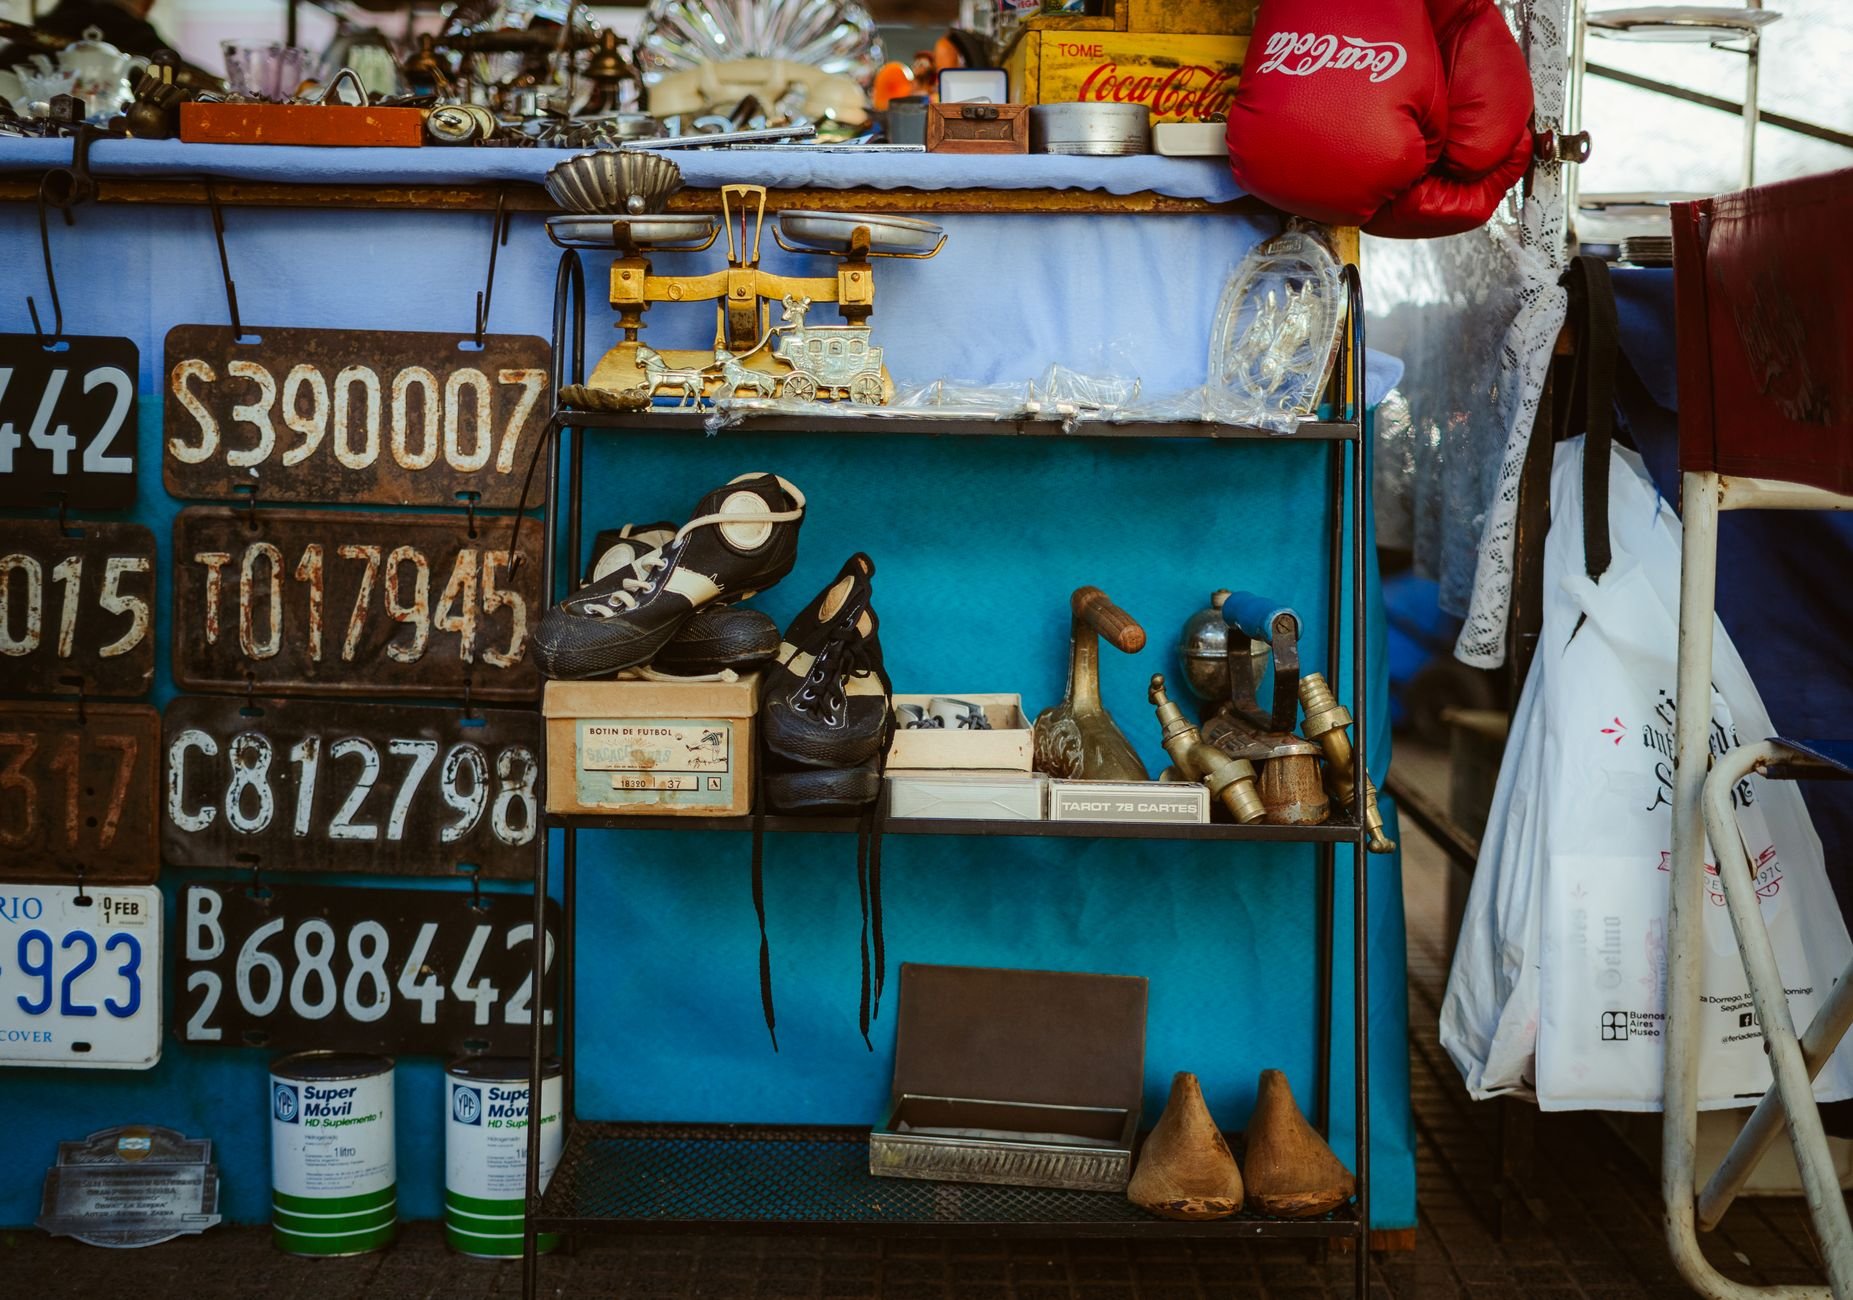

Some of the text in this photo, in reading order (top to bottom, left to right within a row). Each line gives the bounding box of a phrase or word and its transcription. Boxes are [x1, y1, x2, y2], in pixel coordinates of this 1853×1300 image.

[1058, 43, 1104, 58] TOME
[1256, 32, 1407, 83] Coca-Cola
[1077, 63, 1234, 118] Coca-Cola
[168, 359, 549, 474] S390007
[0, 554, 149, 658] 015
[194, 542, 528, 668] T017945
[589, 728, 672, 736] BOTIN DE FUTBOL
[0, 732, 138, 850] 317
[168, 729, 539, 846] C812798
[667, 780, 681, 789] 37
[1062, 801, 1198, 814] TAROT 78 CARTES
[115, 902, 139, 915] FEB
[16, 929, 142, 1019] 923
[235, 916, 556, 1026] 688442
[1630, 1012, 1665, 1020] Buenos
[1630, 1020, 1653, 1028] Aires
[1630, 1028, 1660, 1036] Museo
[304, 1086, 357, 1102] Super
[488, 1087, 529, 1103] Supe
[304, 1102, 352, 1117] Móvil
[488, 1102, 529, 1118] Móvi
[305, 1119, 320, 1127] HD
[322, 1114, 377, 1128] Suplemento
[488, 1119, 503, 1128] HD
